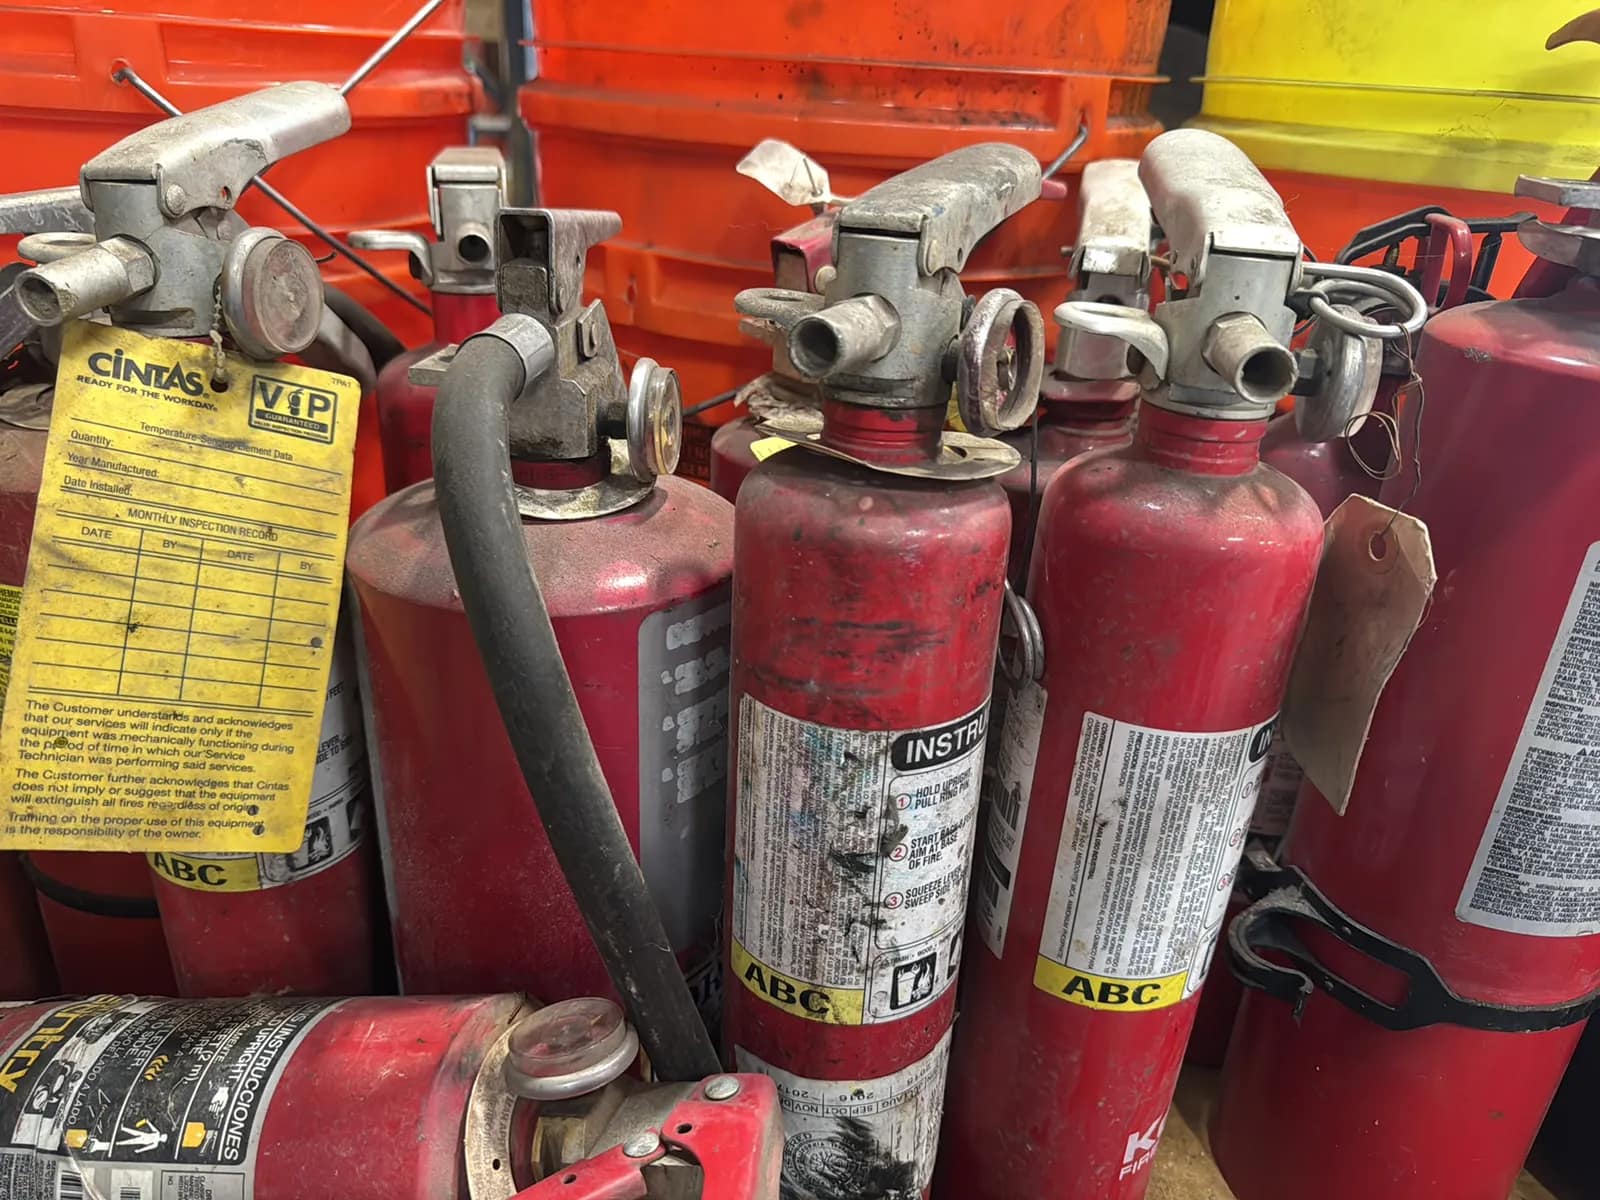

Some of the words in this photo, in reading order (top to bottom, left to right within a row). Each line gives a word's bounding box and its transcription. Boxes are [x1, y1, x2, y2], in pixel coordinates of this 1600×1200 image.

[77, 375, 113, 388] READY
[116, 384, 138, 395] FOR
[141, 389, 160, 399] THE
[265, 413, 320, 430] GUARANTEED
[71, 430, 113, 448] Quantity:
[68, 452, 89, 465] Year
[91, 456, 159, 477] Manufactured:
[274, 450, 293, 461] Data
[64, 475, 87, 487] Date
[90, 480, 133, 496] Installed:
[81, 527, 112, 539] DATE
[128, 508, 178, 524] MONTHLY
[179, 517, 236, 534] INSPECTION
[240, 527, 278, 541] RECORD
[162, 540, 177, 549] BY
[227, 550, 254, 561] DATE
[300, 562, 313, 570] BY
[24, 713, 48, 723] that
[52, 716, 72, 724] our
[76, 719, 126, 729] services
[130, 721, 148, 731] will
[152, 722, 197, 734] indicate
[200, 727, 223, 738] only
[226, 728, 233, 737] if
[236, 729, 252, 739] the
[26, 700, 49, 710] The
[53, 702, 114, 715] Customer
[118, 707, 189, 720] understands
[192, 715, 214, 723] and
[217, 717, 293, 731] acknowledges
[20, 738, 40, 748] the
[43, 740, 84, 750] pod
[87, 741, 100, 751] of
[103, 743, 129, 753] time
[132, 745, 142, 754] in
[146, 747, 179, 756] which
[183, 750, 200, 758] our
[205, 750, 245, 761] Service
[22, 726, 88, 738] equipment
[93, 731, 116, 740] was
[120, 734, 195, 748] mechanically
[198, 738, 258, 752] functioning
[261, 743, 294, 754] during
[18, 750, 84, 762] Technician
[88, 755, 112, 764] was
[116, 756, 179, 770] performing
[183, 761, 206, 770] said
[209, 762, 256, 773] services.
[16, 768, 39, 779] The
[42, 769, 104, 781] Customer
[107, 773, 146, 784] further
[149, 776, 229, 789] acknowledges
[233, 780, 254, 790] that
[256, 780, 290, 791] Cintas
[12, 781, 44, 792] does
[48, 784, 68, 792] not
[72, 784, 105, 795] imply
[108, 787, 121, 795] or
[124, 787, 171, 798] suggest
[175, 789, 196, 799] that
[200, 789, 216, 799] the
[219, 791, 276, 802] equipment
[915, 795, 938, 810] PULL
[940, 784, 957, 800] RING
[916, 784, 940, 799] HOLD
[10, 794, 32, 804] will
[35, 796, 98, 807] extinguish
[102, 797, 115, 807] all
[119, 798, 144, 808] fires
[147, 800, 206, 811] regardless
[209, 802, 220, 811] of
[9, 812, 57, 824] Training
[61, 815, 77, 824] on
[81, 814, 101, 824] the
[103, 816, 144, 826] proper
[171, 817, 181, 826] of
[185, 818, 205, 827] this
[208, 820, 264, 829] equipment
[5, 825, 16, 834] is
[20, 825, 40, 835] the
[44, 826, 125, 838] responsibility
[128, 827, 141, 837] of
[144, 829, 161, 838] the
[165, 830, 201, 838] owner.
[911, 832, 939, 848] START
[908, 847, 927, 860] AIM
[928, 842, 939, 854] AT
[941, 833, 958, 850] BASE
[154, 852, 226, 886] ABC
[909, 859, 920, 870] OF
[904, 892, 934, 909] SWEEP
[936, 883, 951, 898] SIDE
[906, 878, 942, 899] SQUEEZE
[745, 962, 830, 1015] ABC
[1062, 975, 1161, 1005] ABC
[0, 994, 122, 1094] ntry
[87, 1054, 109, 1080] LADO
[81, 1082, 90, 1091] A
[221, 1025, 292, 1161] INSTRUCCIONES
[794, 1103, 818, 1112] NOV
[825, 1107, 847, 1115] OCT
[852, 1104, 872, 1114] SEP
[881, 1094, 901, 1108] AUG
[1123, 1108, 1170, 1164] K
